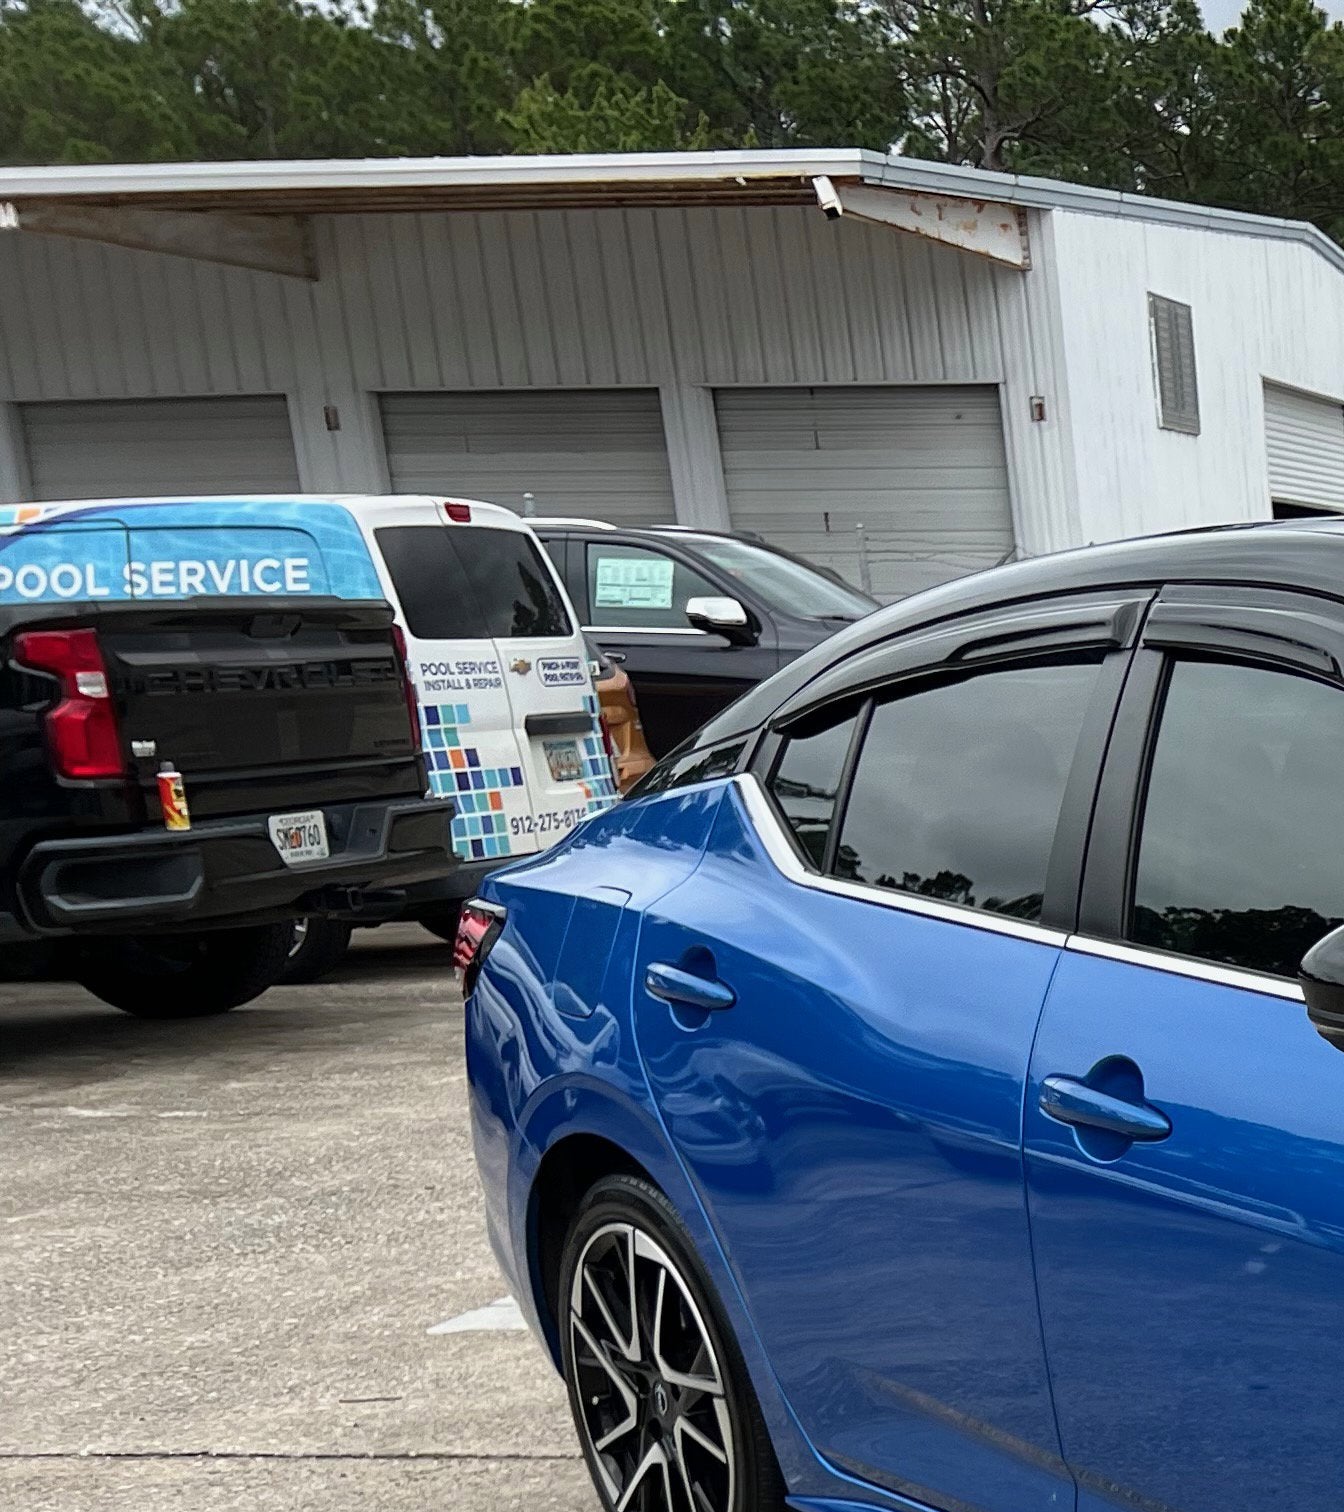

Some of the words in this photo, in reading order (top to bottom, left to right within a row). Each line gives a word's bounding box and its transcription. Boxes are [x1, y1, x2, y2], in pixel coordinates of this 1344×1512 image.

[122, 557, 311, 595] SERVICE
[420, 661, 455, 676] POOL
[455, 660, 499, 675] SERVICE
[424, 679, 464, 691] INSTALL
